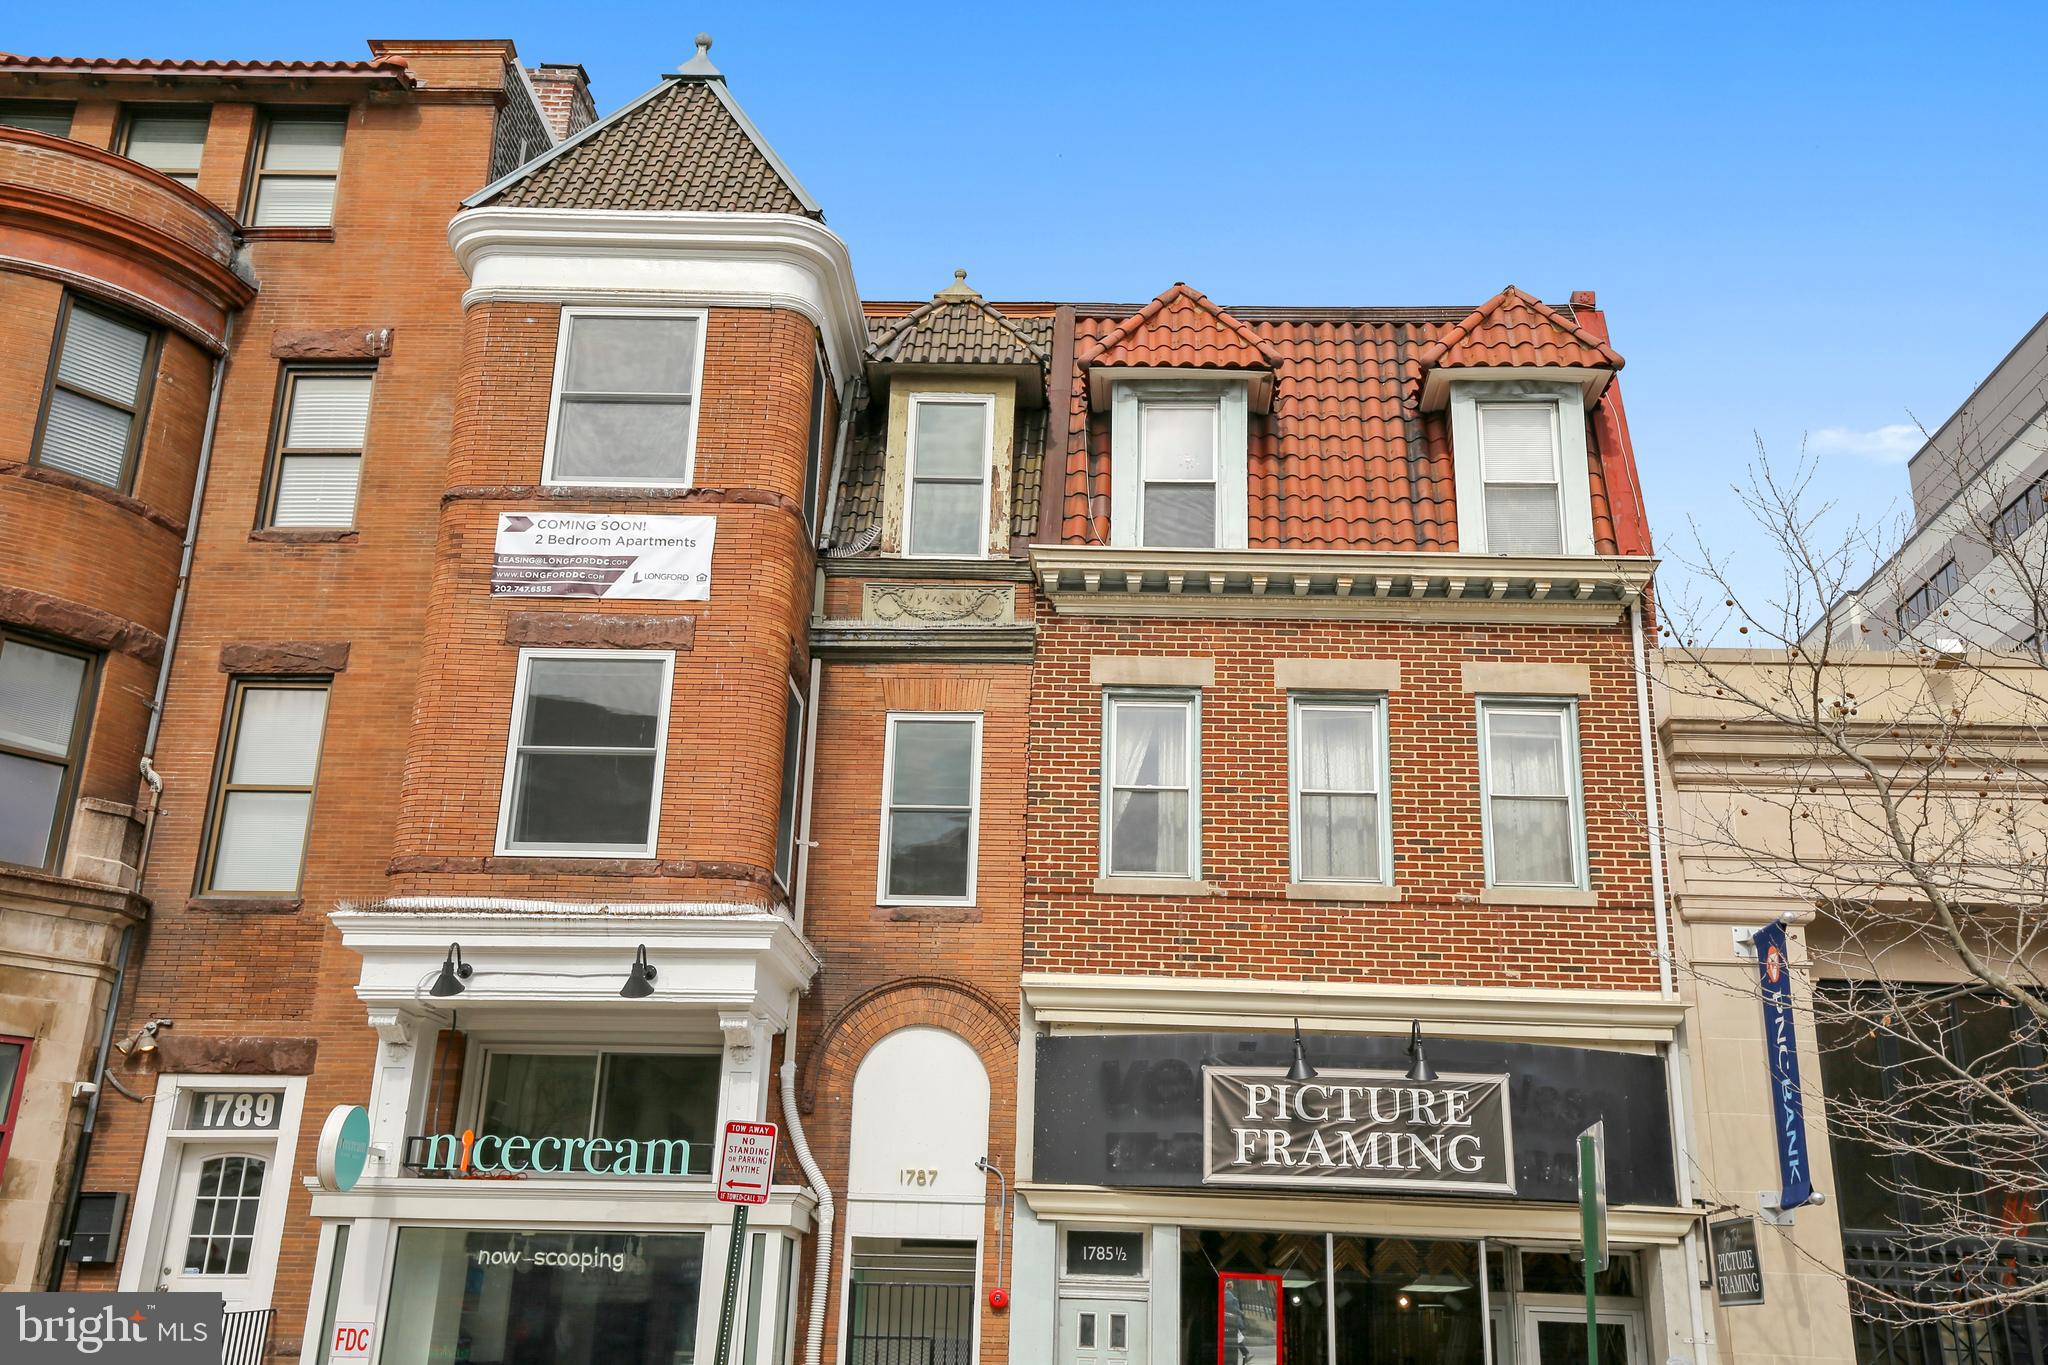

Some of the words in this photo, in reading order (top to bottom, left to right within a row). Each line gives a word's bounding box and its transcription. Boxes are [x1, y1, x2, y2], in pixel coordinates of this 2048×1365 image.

[537, 519, 596, 531] COMING
[600, 520, 647, 532] SOON!
[535, 535, 543, 545] 2
[548, 535, 611, 547] Bedroom
[615, 536, 697, 549] Apartments
[497, 556, 628, 566] LEASING@LONGFORDDC.COM
[644, 572, 690, 581] LONGFORD
[494, 585, 552, 593] 202.747.6555
[1772, 992, 1791, 1071] PNC
[203, 1093, 276, 1127] 1789
[1242, 1083, 1473, 1128] PICTURE
[749, 1126, 769, 1134] AWAY
[1781, 1078, 1802, 1185] BANK
[422, 1129, 692, 1176] nicecream
[729, 1146, 769, 1156] STANDING
[738, 1155, 768, 1165] PARKING
[1231, 1127, 1485, 1173] FRAMING
[731, 1165, 759, 1174] ANYTIME
[900, 1168, 938, 1187] 1787
[478, 1250, 521, 1265] now
[534, 1246, 624, 1273] scooping
[1717, 1249, 1755, 1272] PICTURE
[1719, 1272, 1760, 1295] FRAMING
[335, 1328, 369, 1351] FDC
